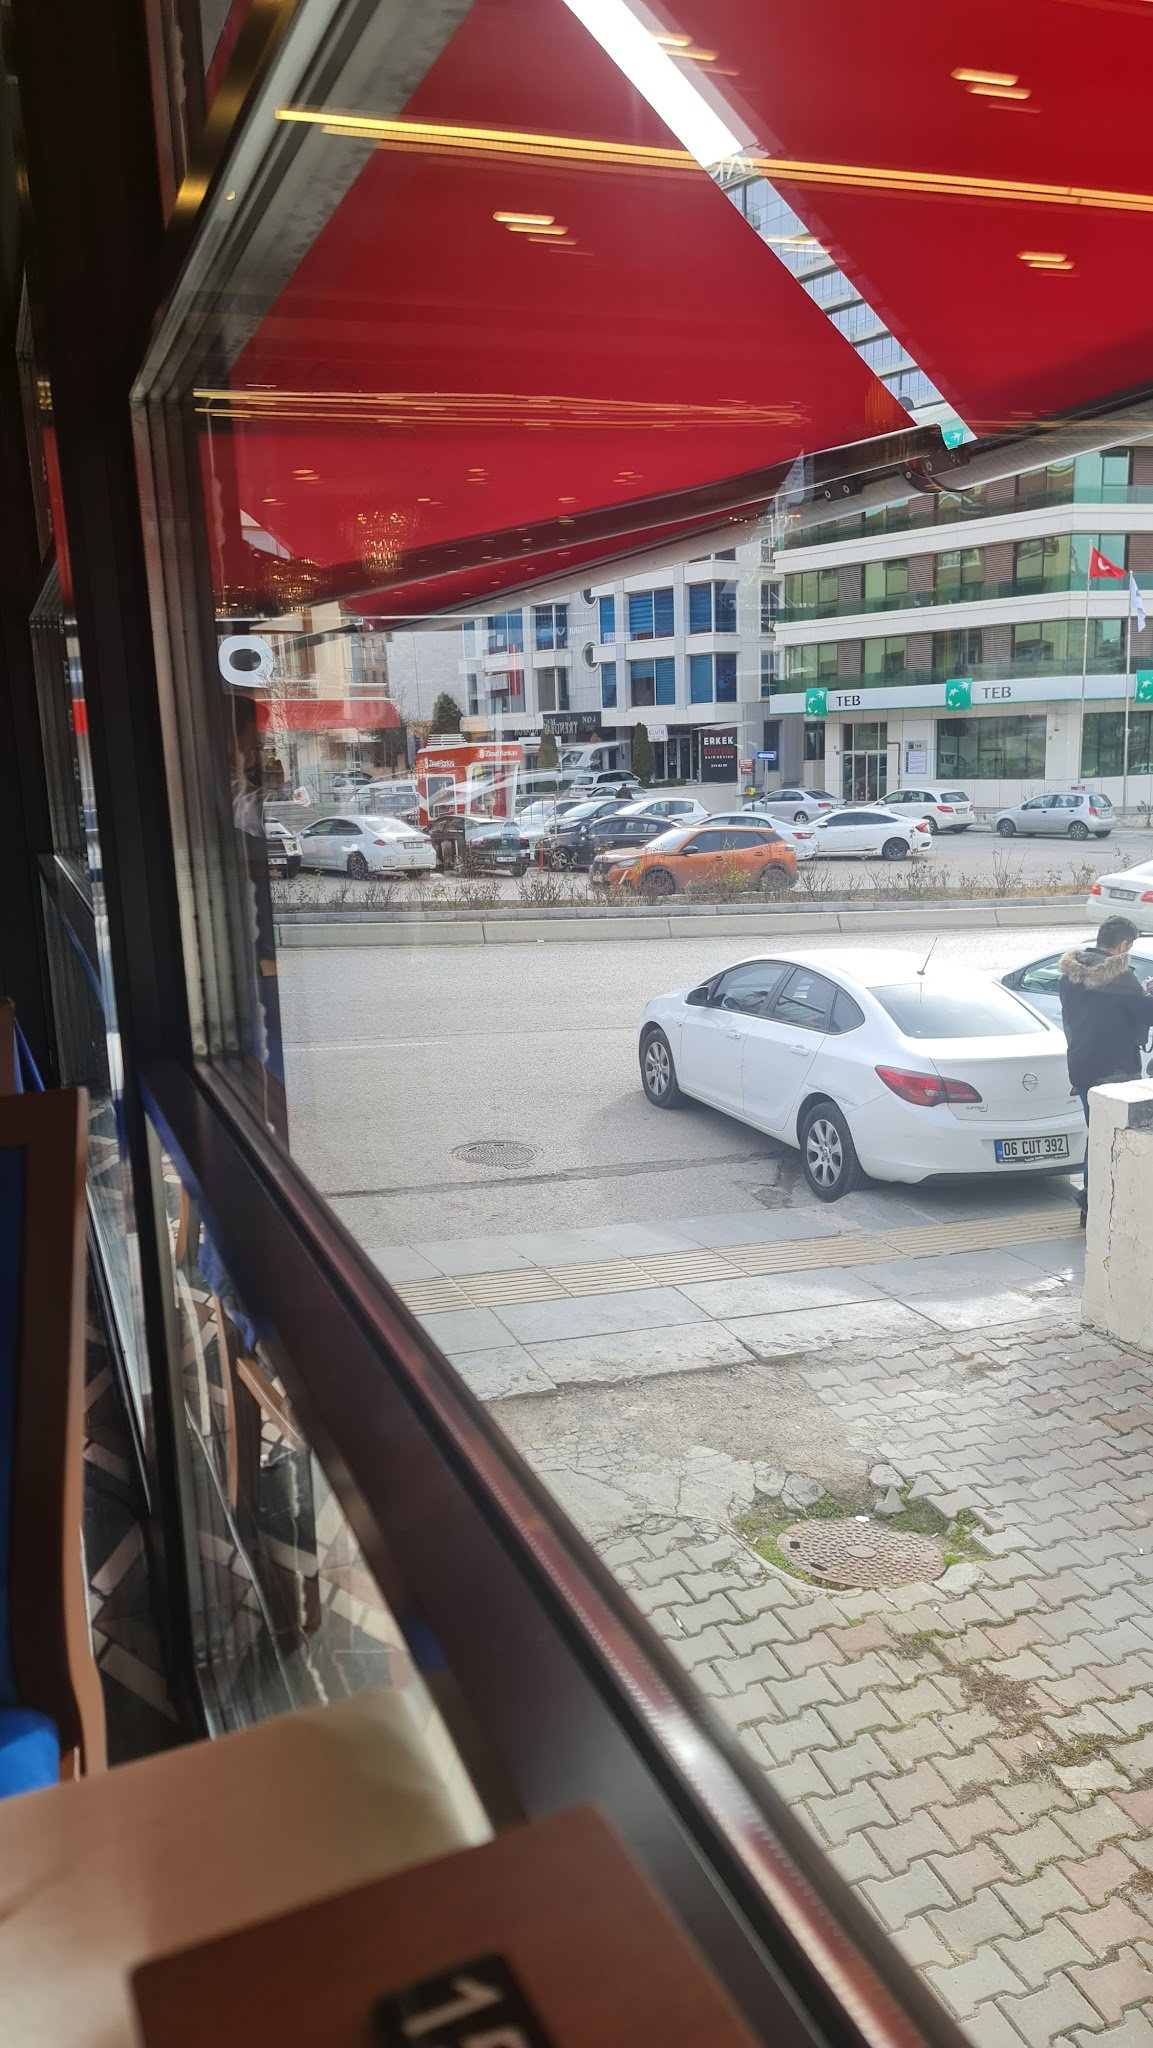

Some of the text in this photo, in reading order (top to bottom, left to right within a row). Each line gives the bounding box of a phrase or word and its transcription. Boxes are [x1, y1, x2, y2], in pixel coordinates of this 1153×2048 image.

[982, 686, 1011, 699] TEB
[836, 695, 861, 707] TEB
[703, 736, 734, 745] ERKEK
[1004, 1138, 1064, 1156] 06 CUT 392
